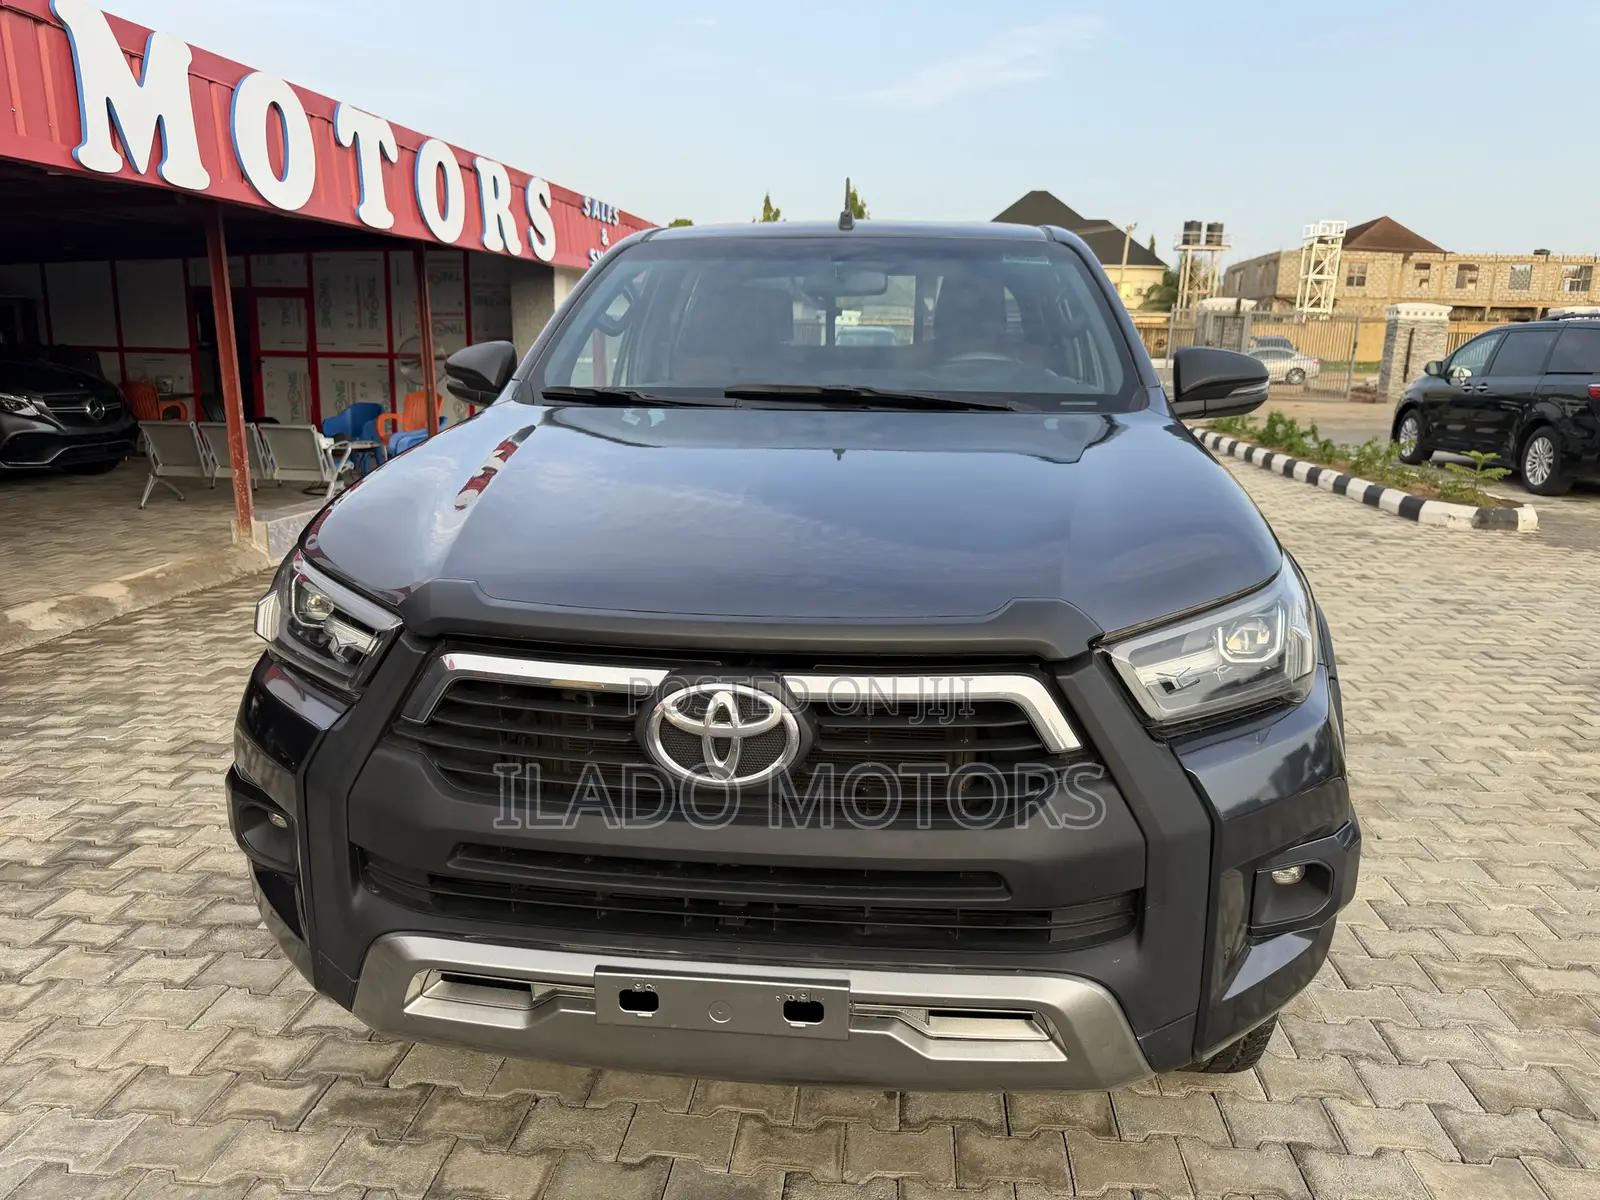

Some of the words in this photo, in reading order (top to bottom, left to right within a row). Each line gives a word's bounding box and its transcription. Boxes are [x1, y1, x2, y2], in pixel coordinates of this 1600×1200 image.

[50, 0, 556, 263] MOTORS
[582, 196, 620, 226] SALES
[600, 228, 609, 246] &
